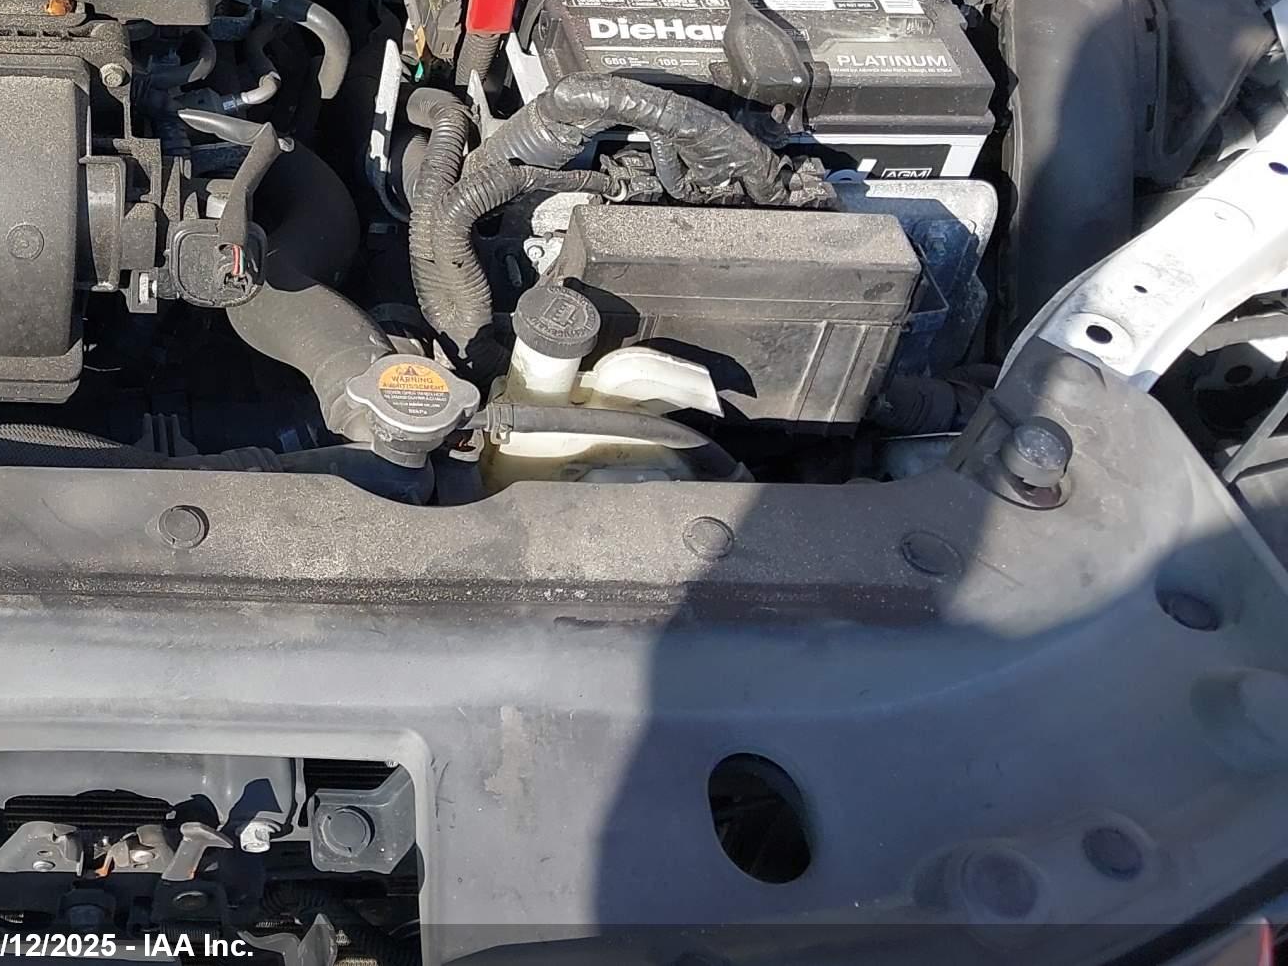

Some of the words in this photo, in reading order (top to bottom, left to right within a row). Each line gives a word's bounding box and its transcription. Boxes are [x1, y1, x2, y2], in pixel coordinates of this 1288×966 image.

[588, 17, 727, 41] DieHar
[837, 55, 948, 67] PLATINUM
[886, 170, 928, 179] AGM
[392, 375, 433, 384] WARNING
